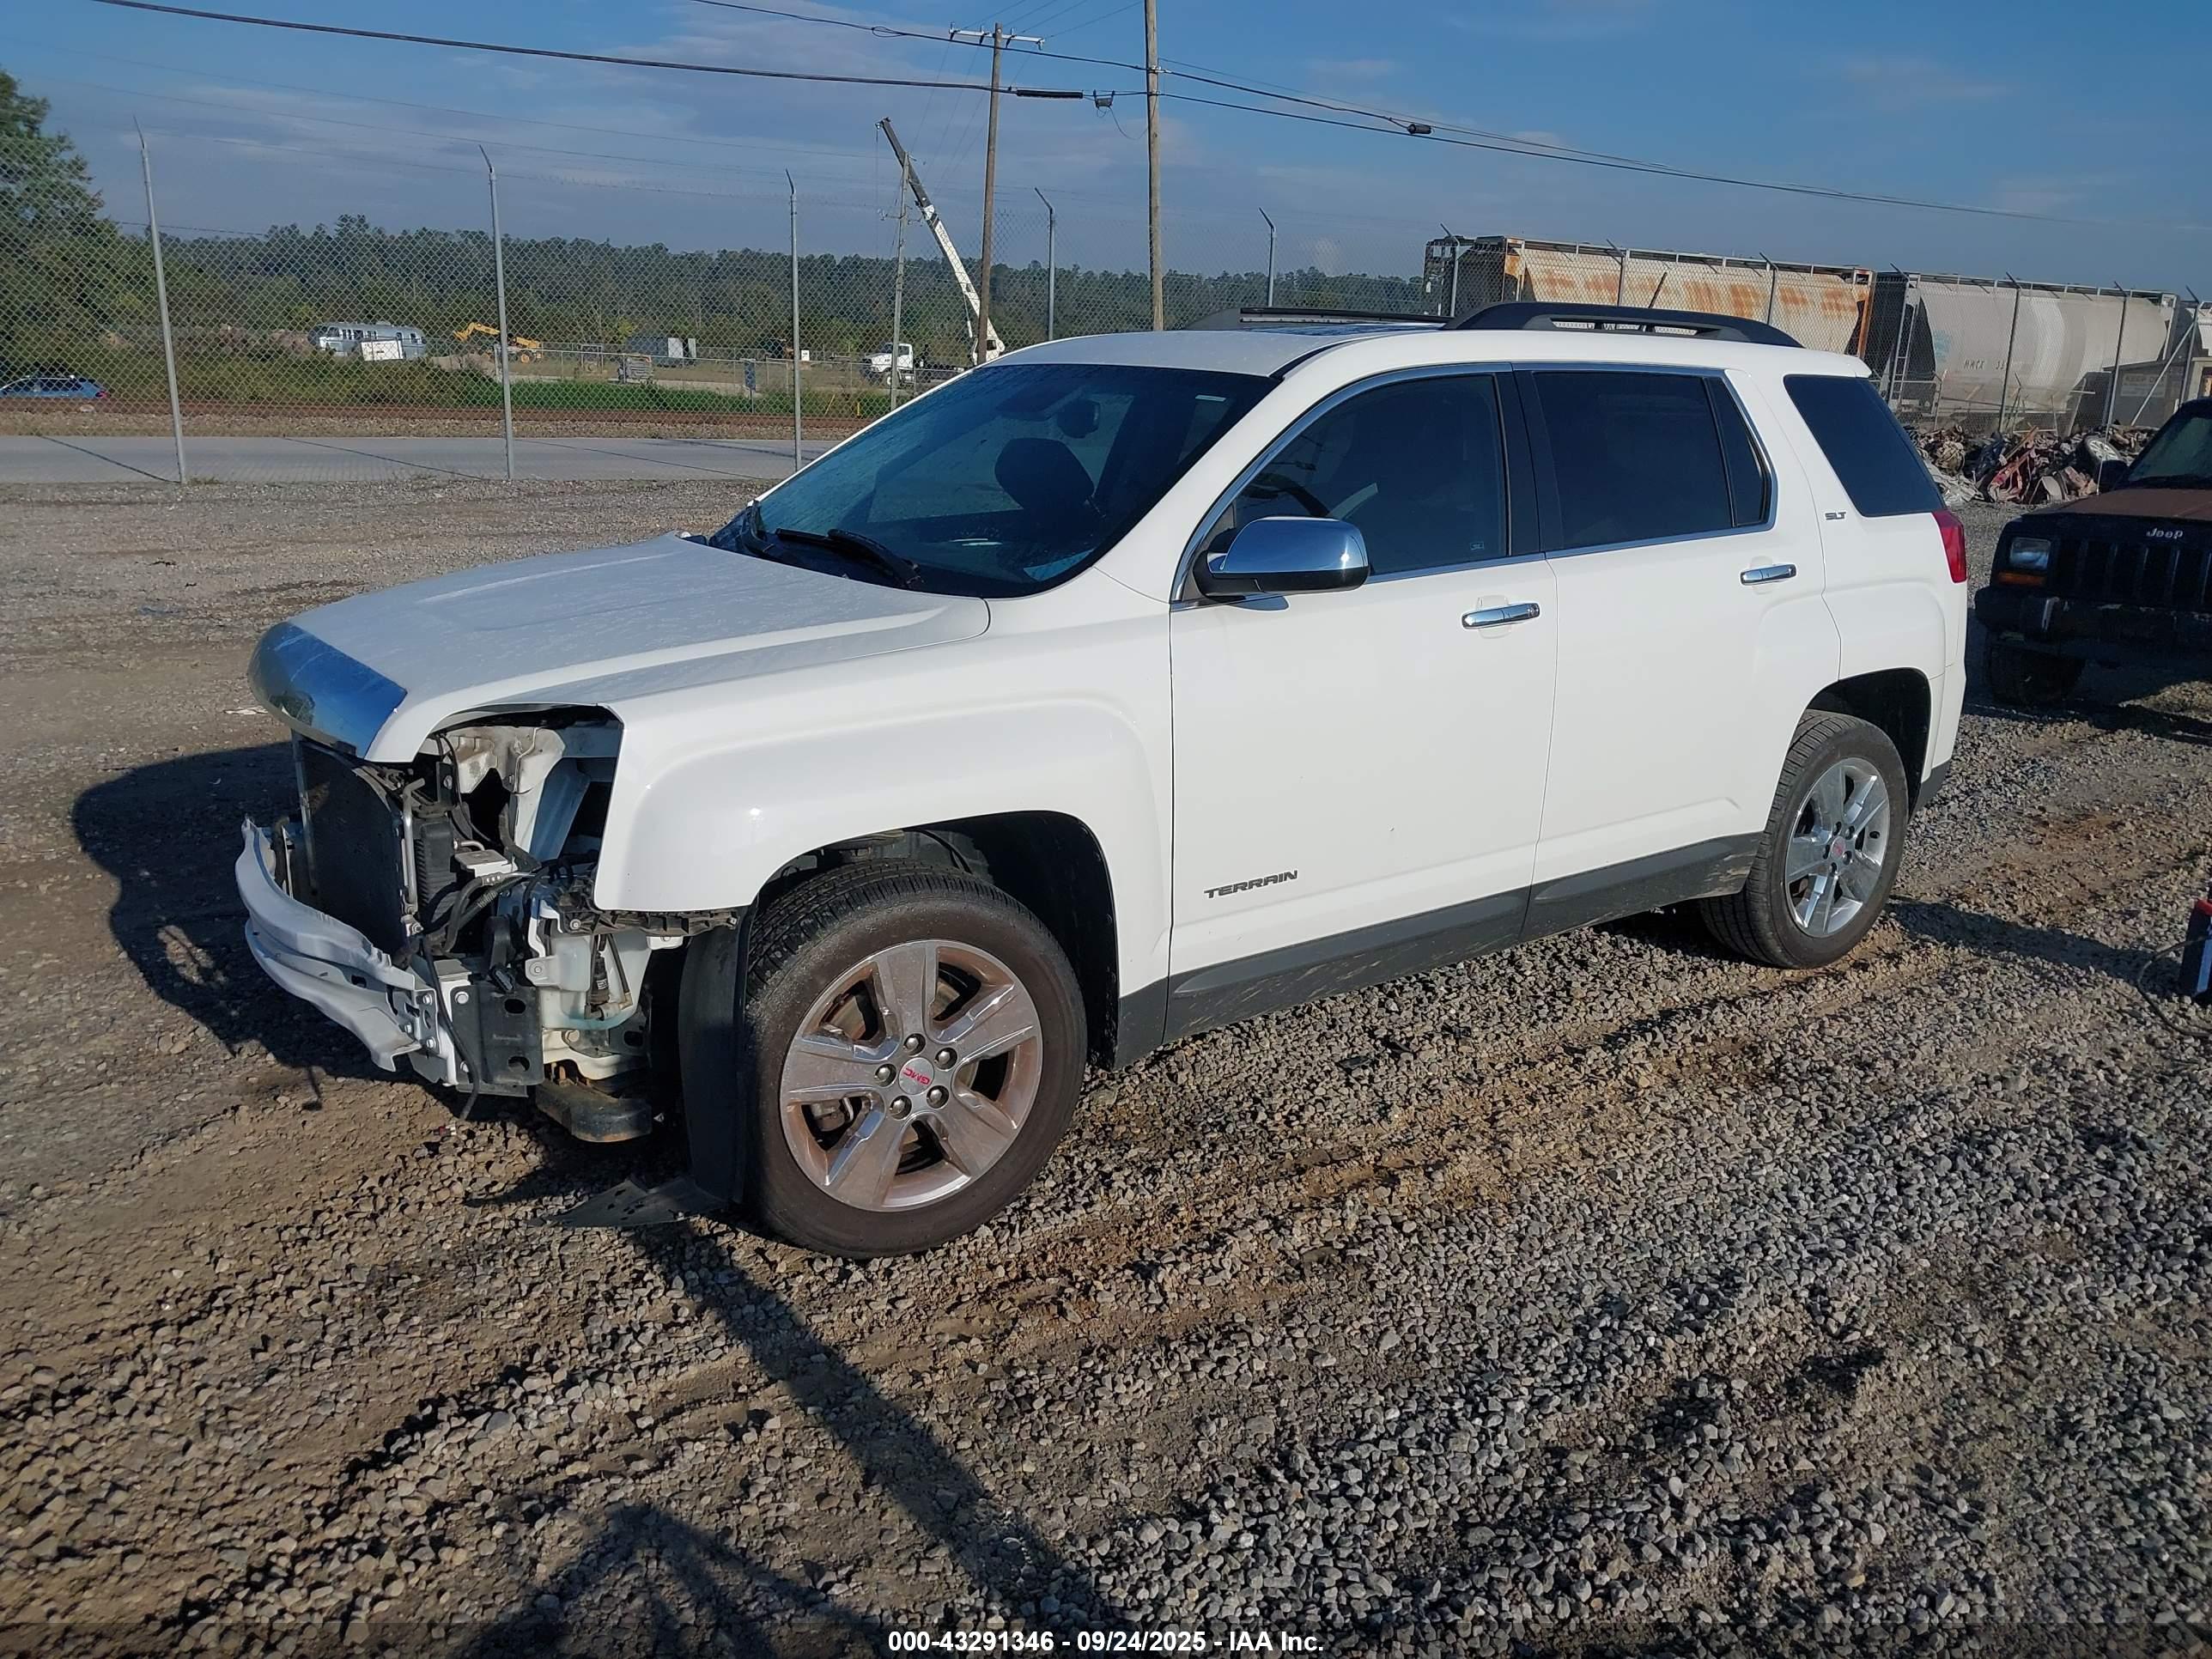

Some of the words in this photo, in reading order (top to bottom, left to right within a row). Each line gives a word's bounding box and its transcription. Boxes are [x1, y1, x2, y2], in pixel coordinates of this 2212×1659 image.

[1825, 512, 1846, 520] SLT
[2146, 527, 2184, 539] Jeep
[1203, 870, 1297, 898] TERRAIN
[903, 1067, 930, 1085] GMC
